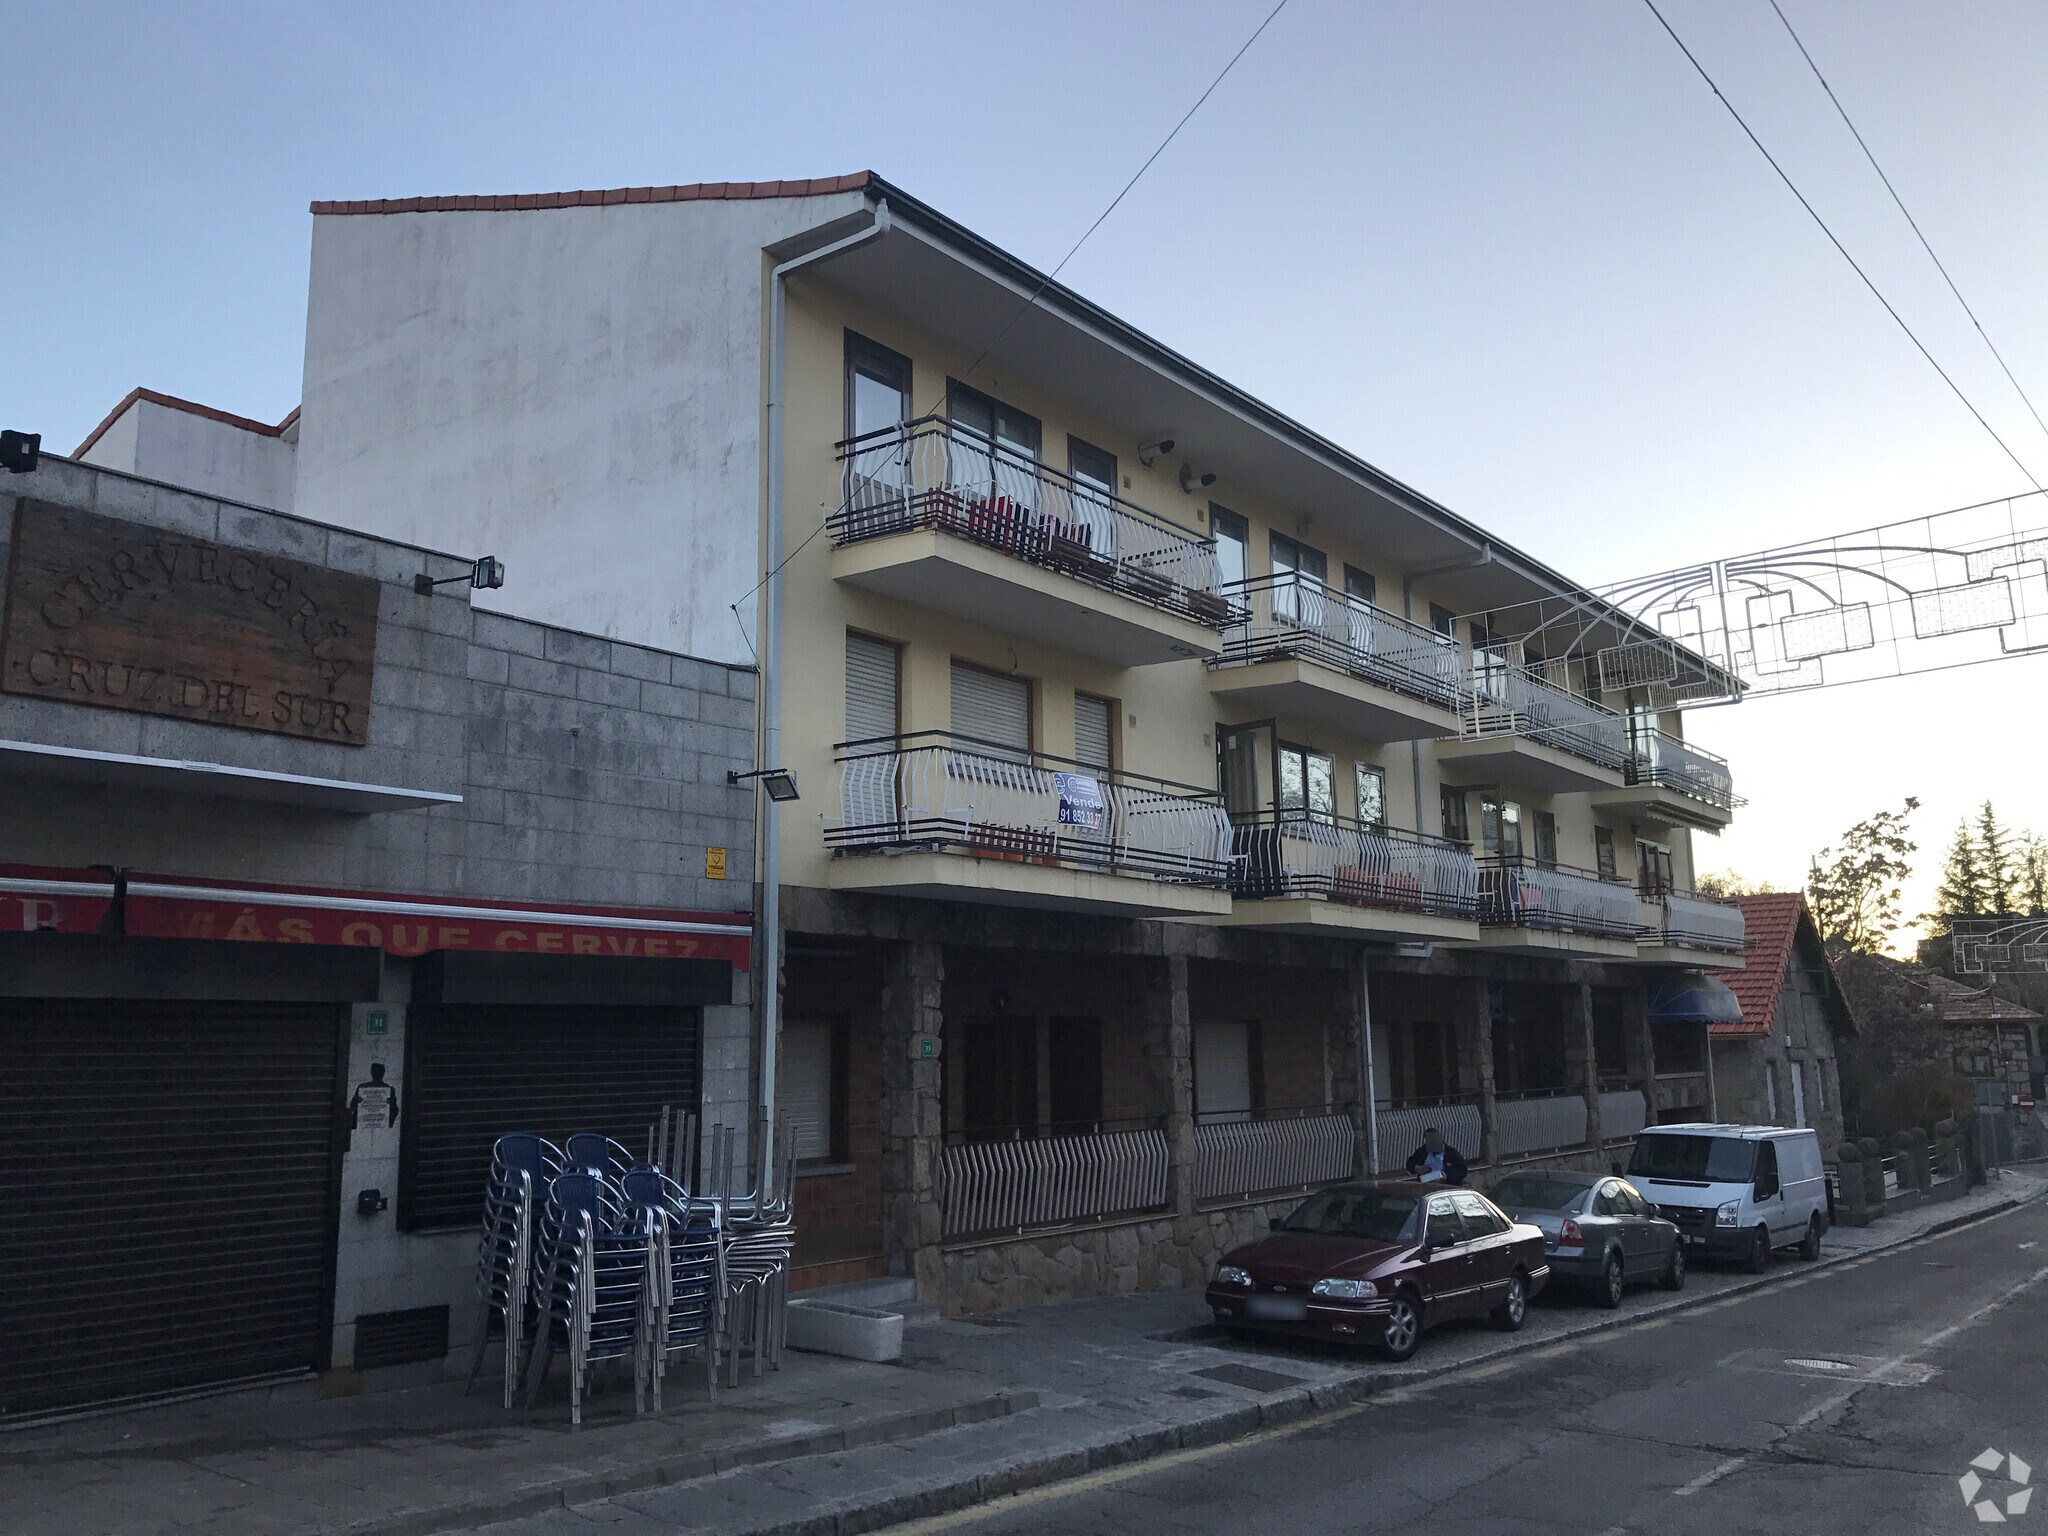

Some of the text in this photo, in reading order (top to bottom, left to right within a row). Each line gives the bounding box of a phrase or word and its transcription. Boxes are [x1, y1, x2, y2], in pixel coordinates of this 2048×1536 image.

[27, 648, 354, 734] CRUZ DEL SUR
[1063, 794, 1102, 809] Vende
[1060, 808, 1070, 822] 91
[1073, 809, 1086, 823] 852
[1086, 811, 1094, 825] 33
[341, 921, 471, 954] QUE
[494, 930, 722, 958] CERVEZ
